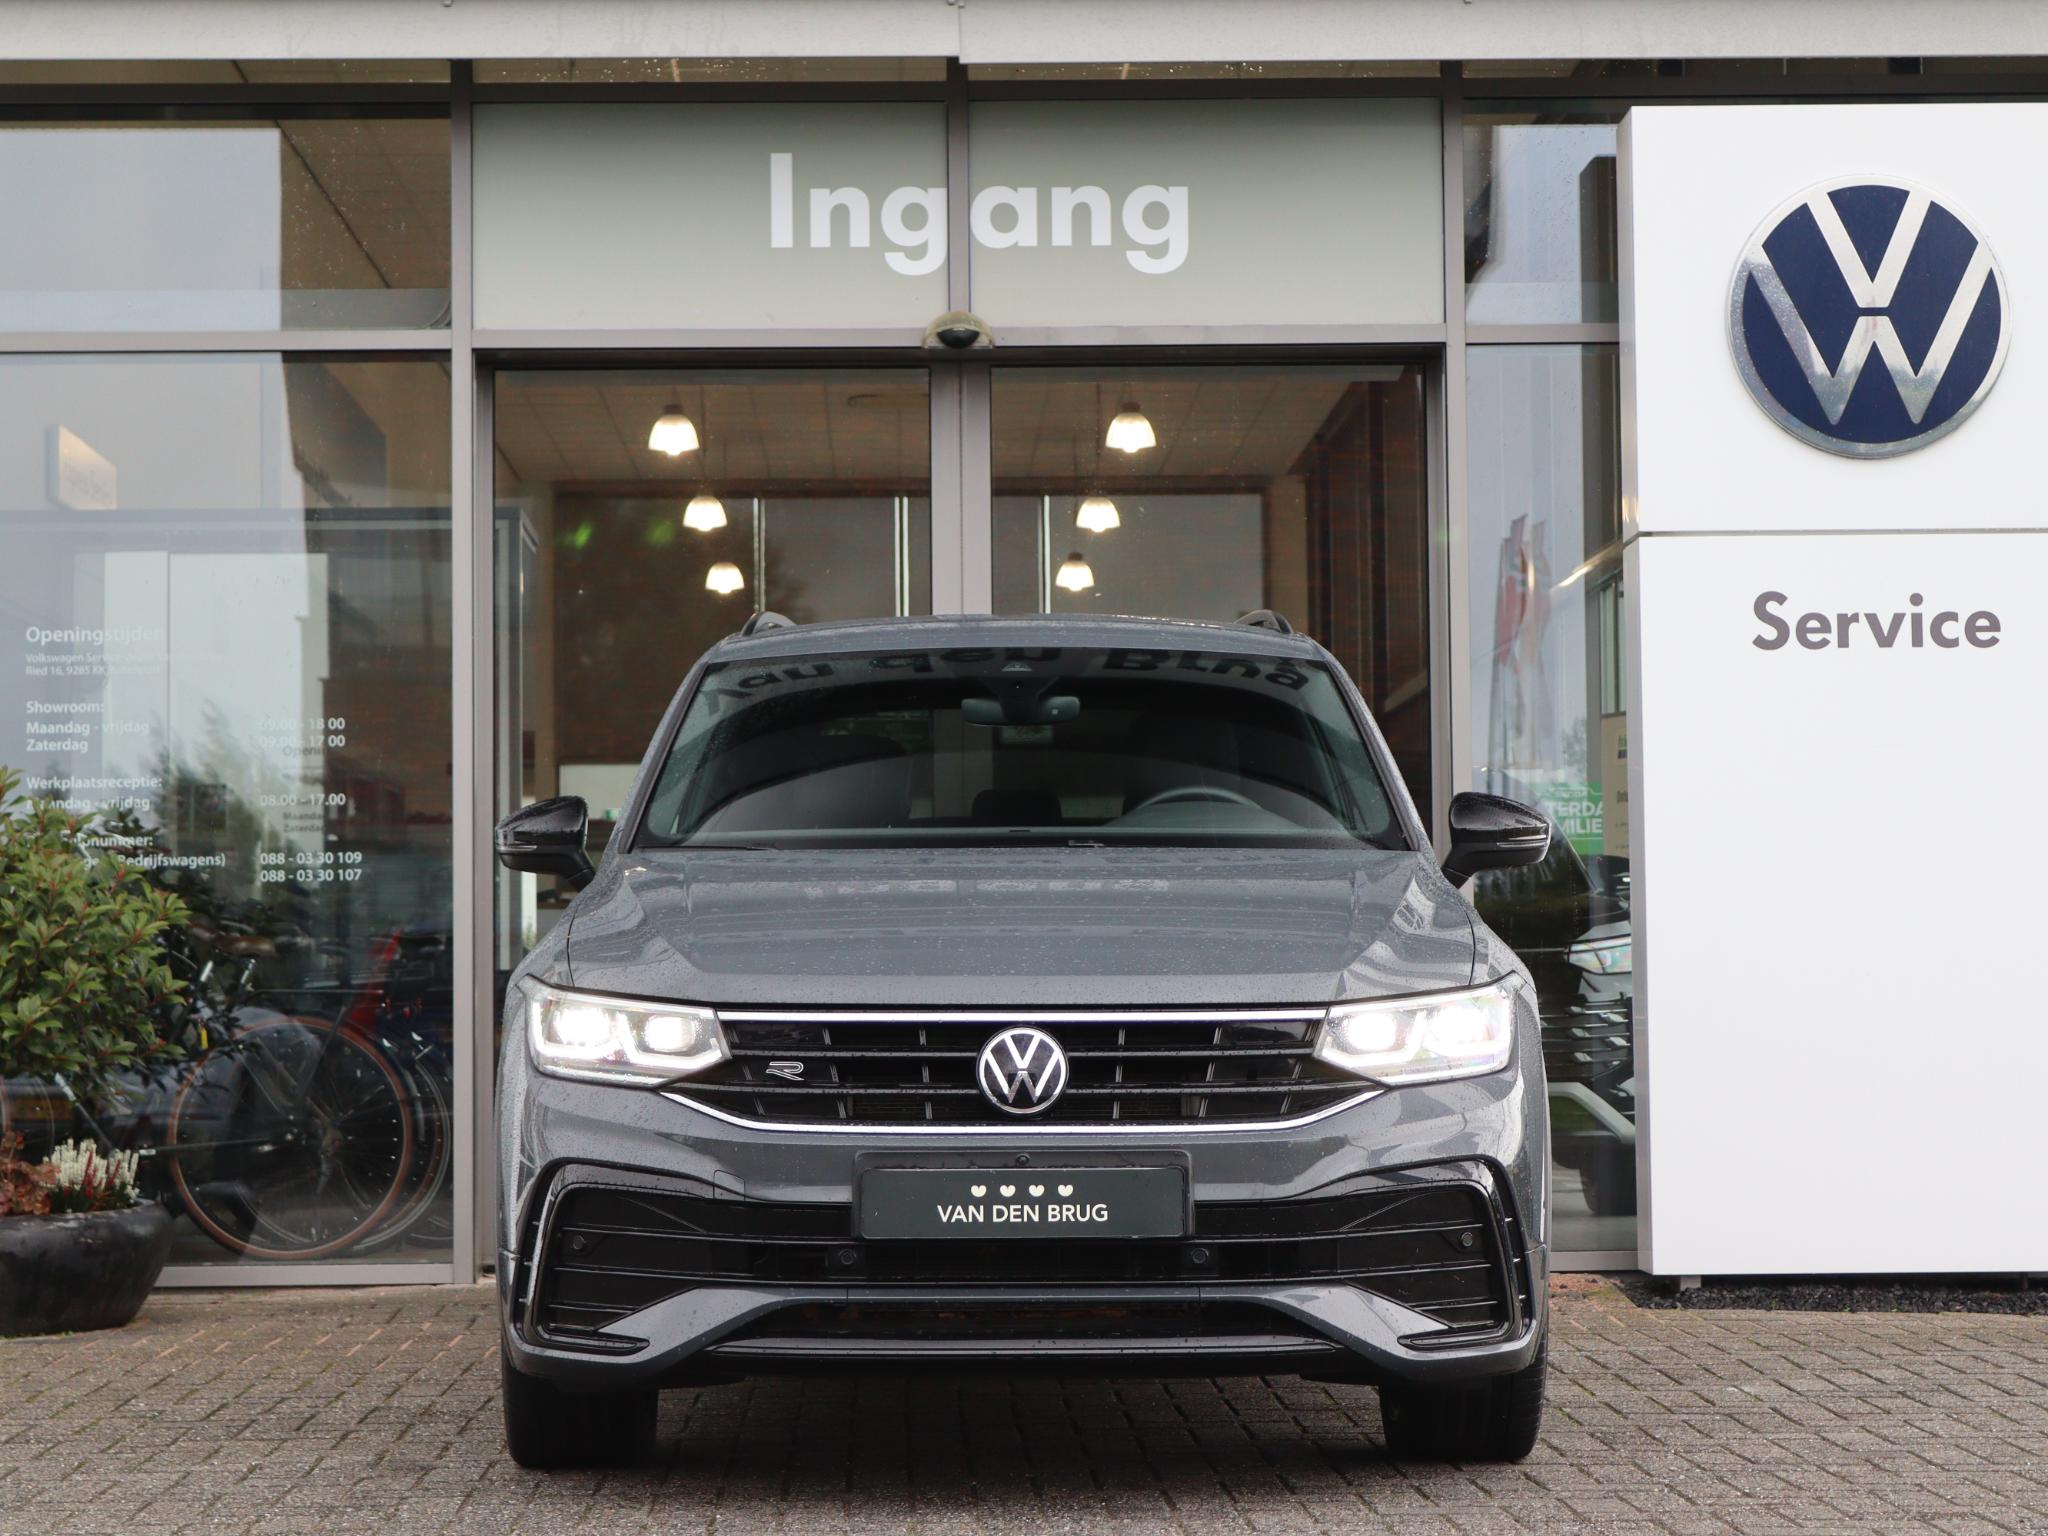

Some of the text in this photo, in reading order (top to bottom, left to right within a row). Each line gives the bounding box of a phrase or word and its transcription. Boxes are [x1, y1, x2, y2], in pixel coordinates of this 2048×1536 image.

[770, 153, 1189, 276] Ingang
[1736, 180, 2006, 440] VW
[1752, 590, 2001, 650] Service
[26, 626, 164, 645] Openingstijden
[26, 701, 105, 714] Showroom:
[26, 721, 91, 736] Maandag
[102, 720, 150, 737] vrijdag
[26, 739, 89, 754] Zaterdag
[26, 776, 163, 791] Werkplaatsreceptie:
[102, 796, 151, 812] vrijdag
[259, 794, 297, 806] 08.00
[310, 793, 346, 806] 17.00
[259, 853, 286, 865] 088
[296, 852, 314, 864] 03
[317, 852, 334, 864] 30
[337, 851, 362, 864] 109
[260, 870, 286, 882] 088
[296, 870, 314, 881] 03
[317, 869, 334, 881] 30
[337, 869, 362, 881] 107
[937, 1204, 1109, 1223] VAN DEN BRUG
